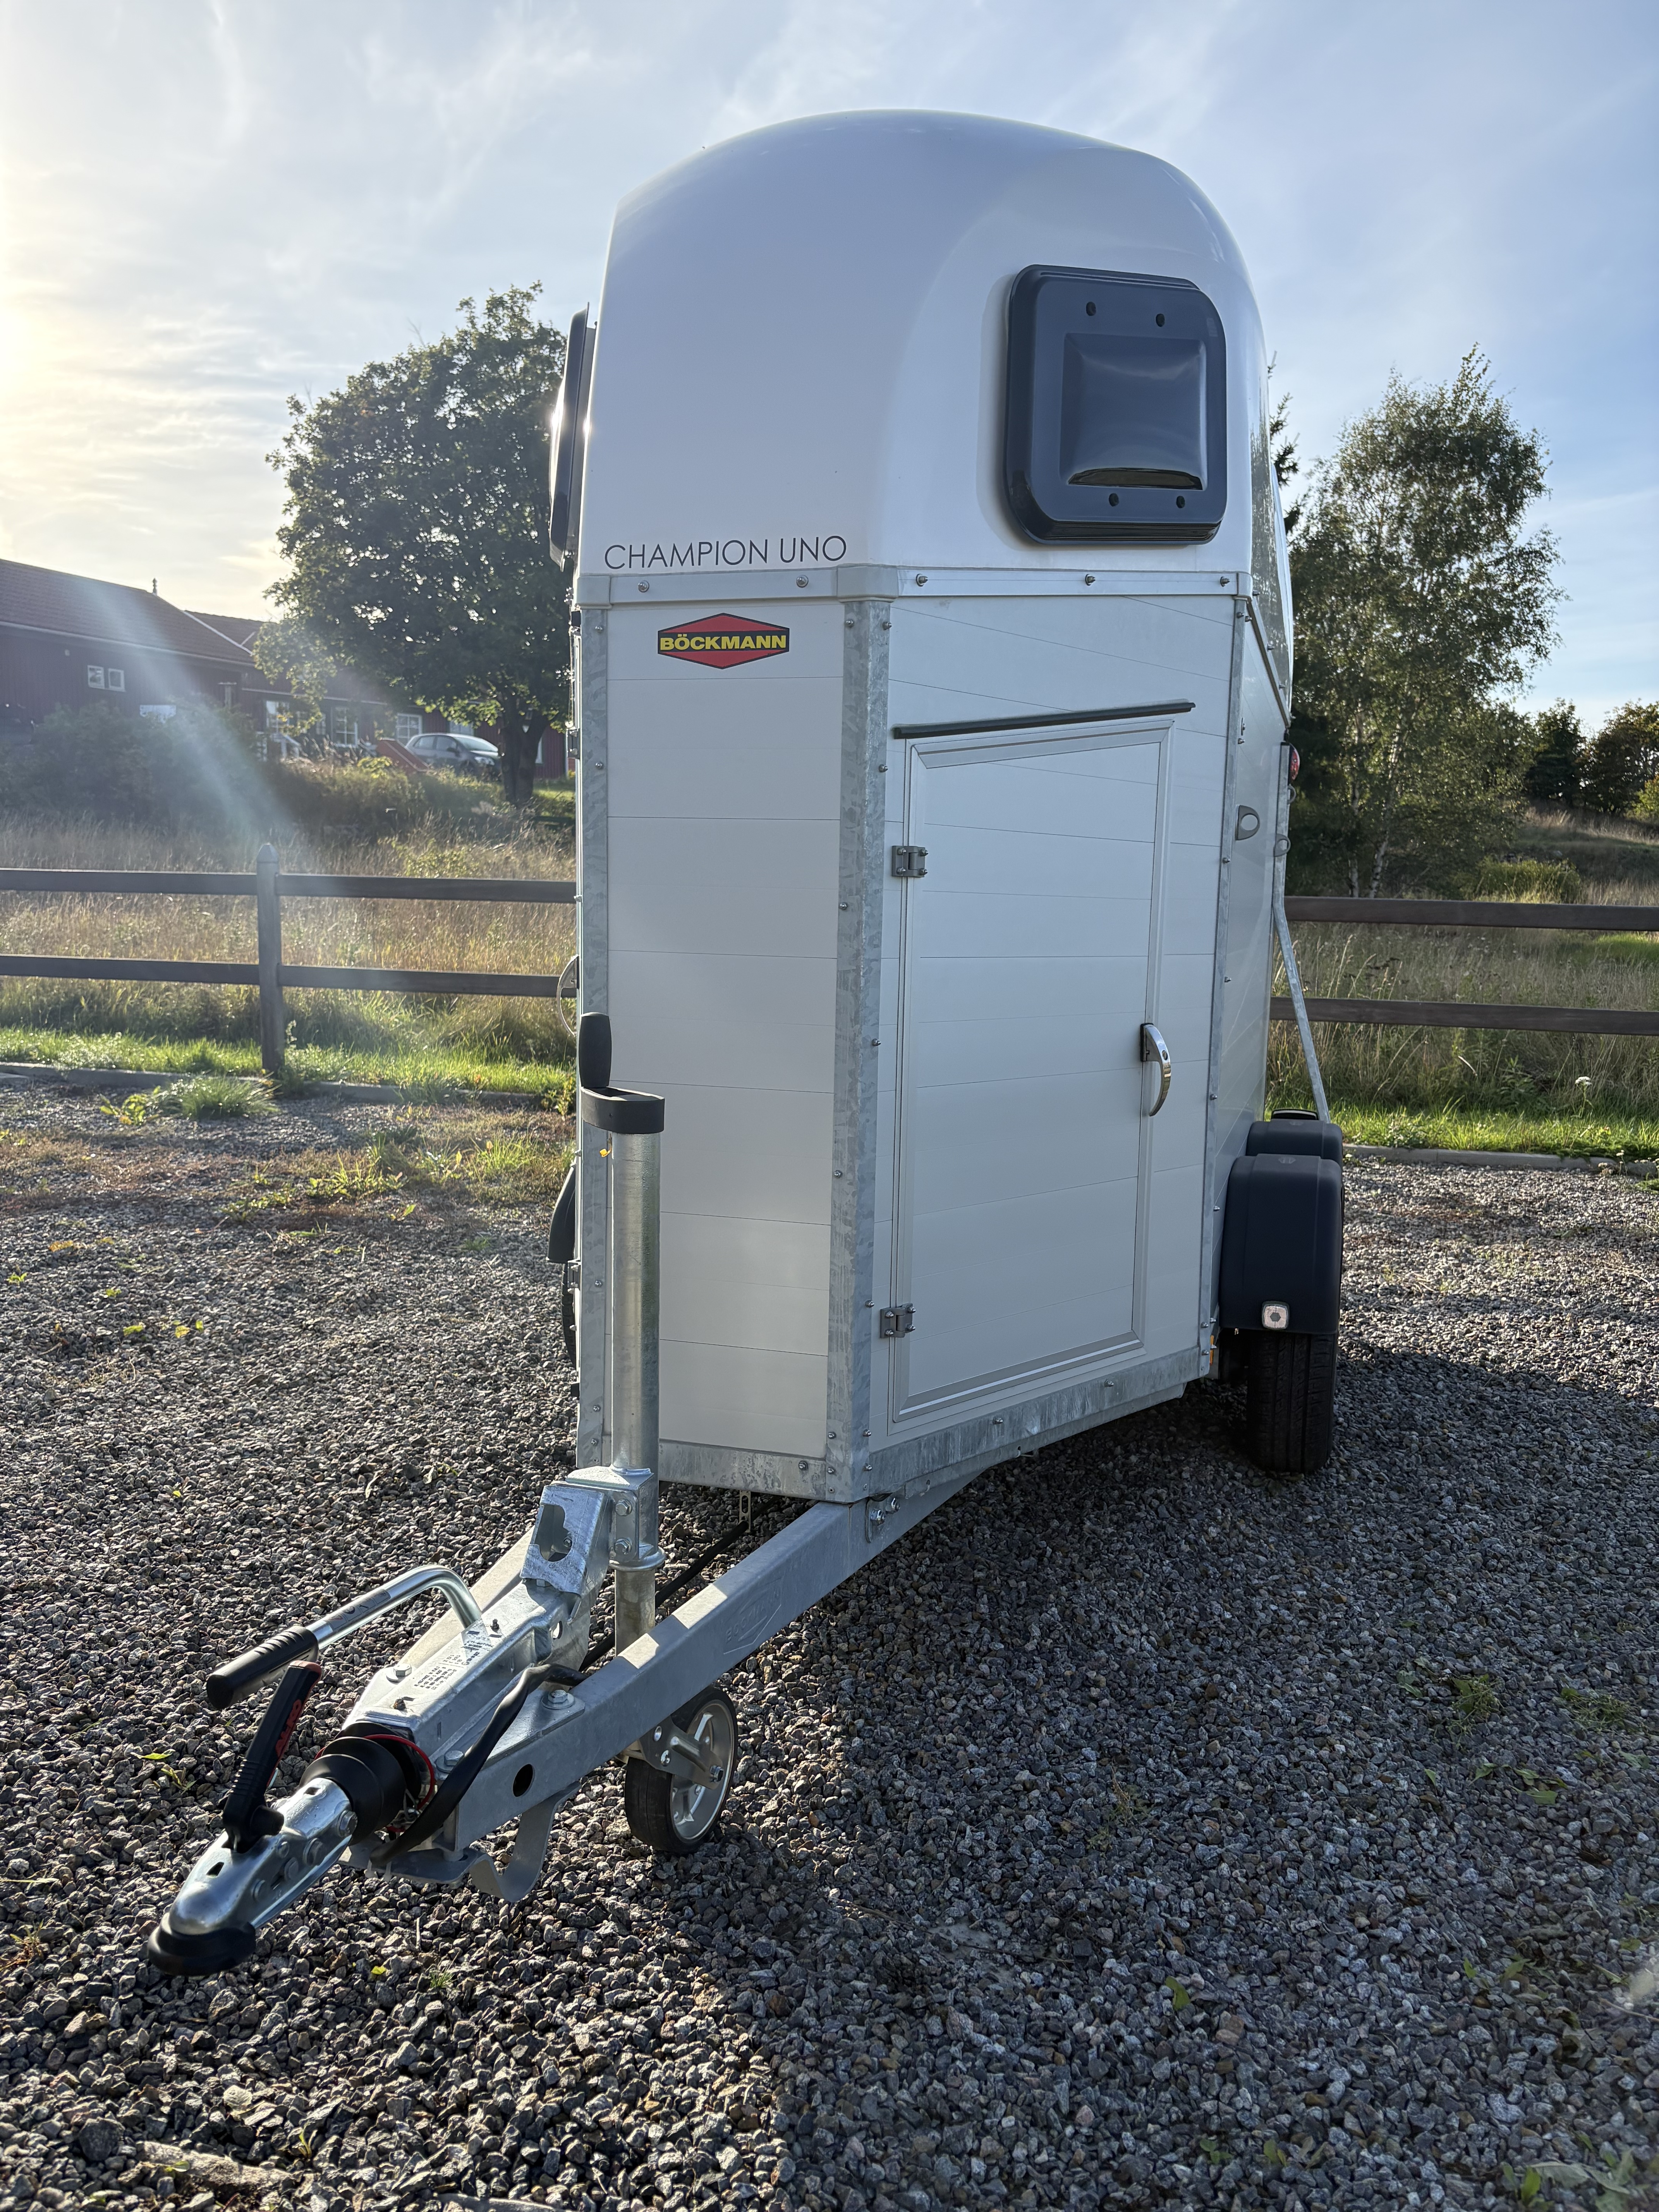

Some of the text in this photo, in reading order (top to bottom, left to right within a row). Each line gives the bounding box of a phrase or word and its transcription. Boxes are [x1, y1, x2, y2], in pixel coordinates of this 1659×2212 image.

[605, 536, 846, 570] CHAMPION UNO
[660, 634, 786, 651] BÖCKMANN
